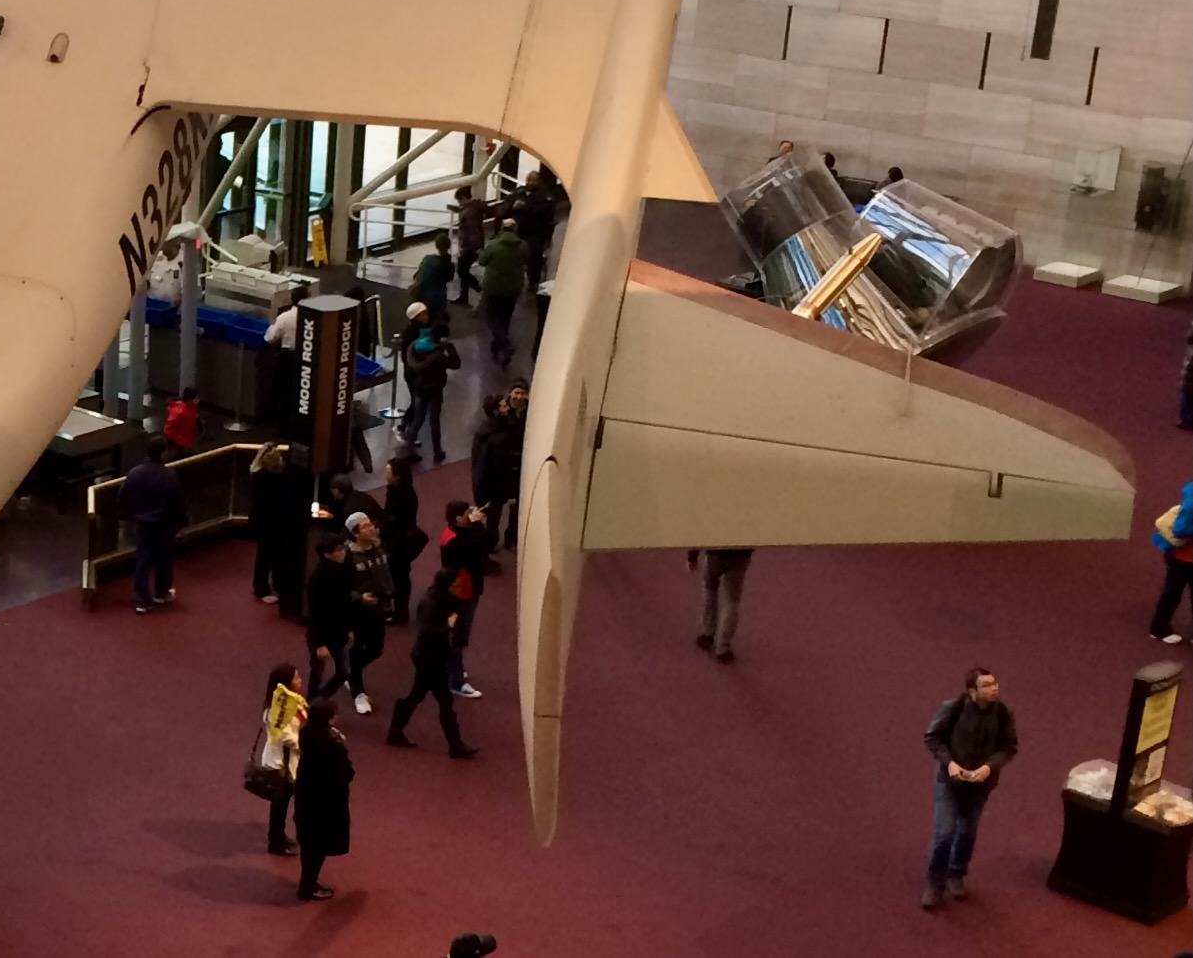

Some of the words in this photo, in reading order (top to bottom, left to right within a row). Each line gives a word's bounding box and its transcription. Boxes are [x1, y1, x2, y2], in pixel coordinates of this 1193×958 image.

[301, 318, 315, 362] ROCK
[340, 319, 352, 363] ROCK
[299, 365, 313, 415] MOON
[336, 366, 349, 415] MOON
